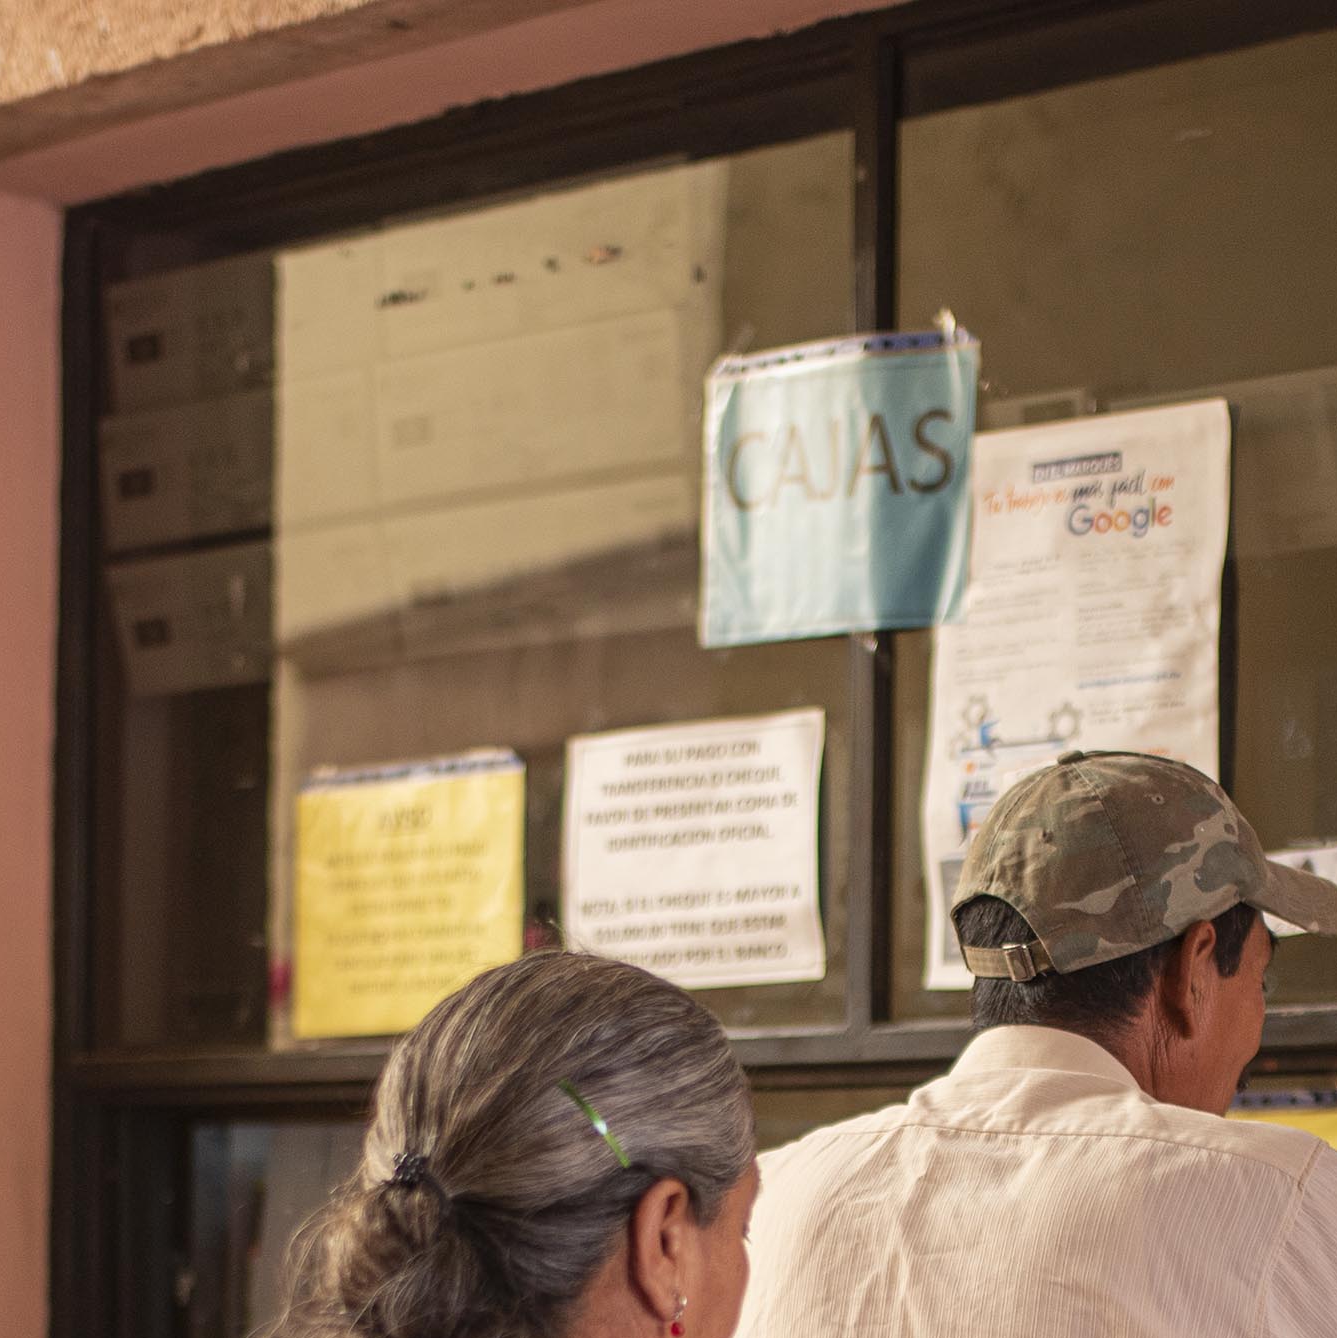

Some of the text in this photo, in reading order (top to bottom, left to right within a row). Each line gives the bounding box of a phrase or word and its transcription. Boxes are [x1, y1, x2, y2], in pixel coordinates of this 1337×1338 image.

[725, 408, 955, 512] CAJAS
[1150, 476, 1175, 491] con
[1068, 498, 1172, 538] Google
